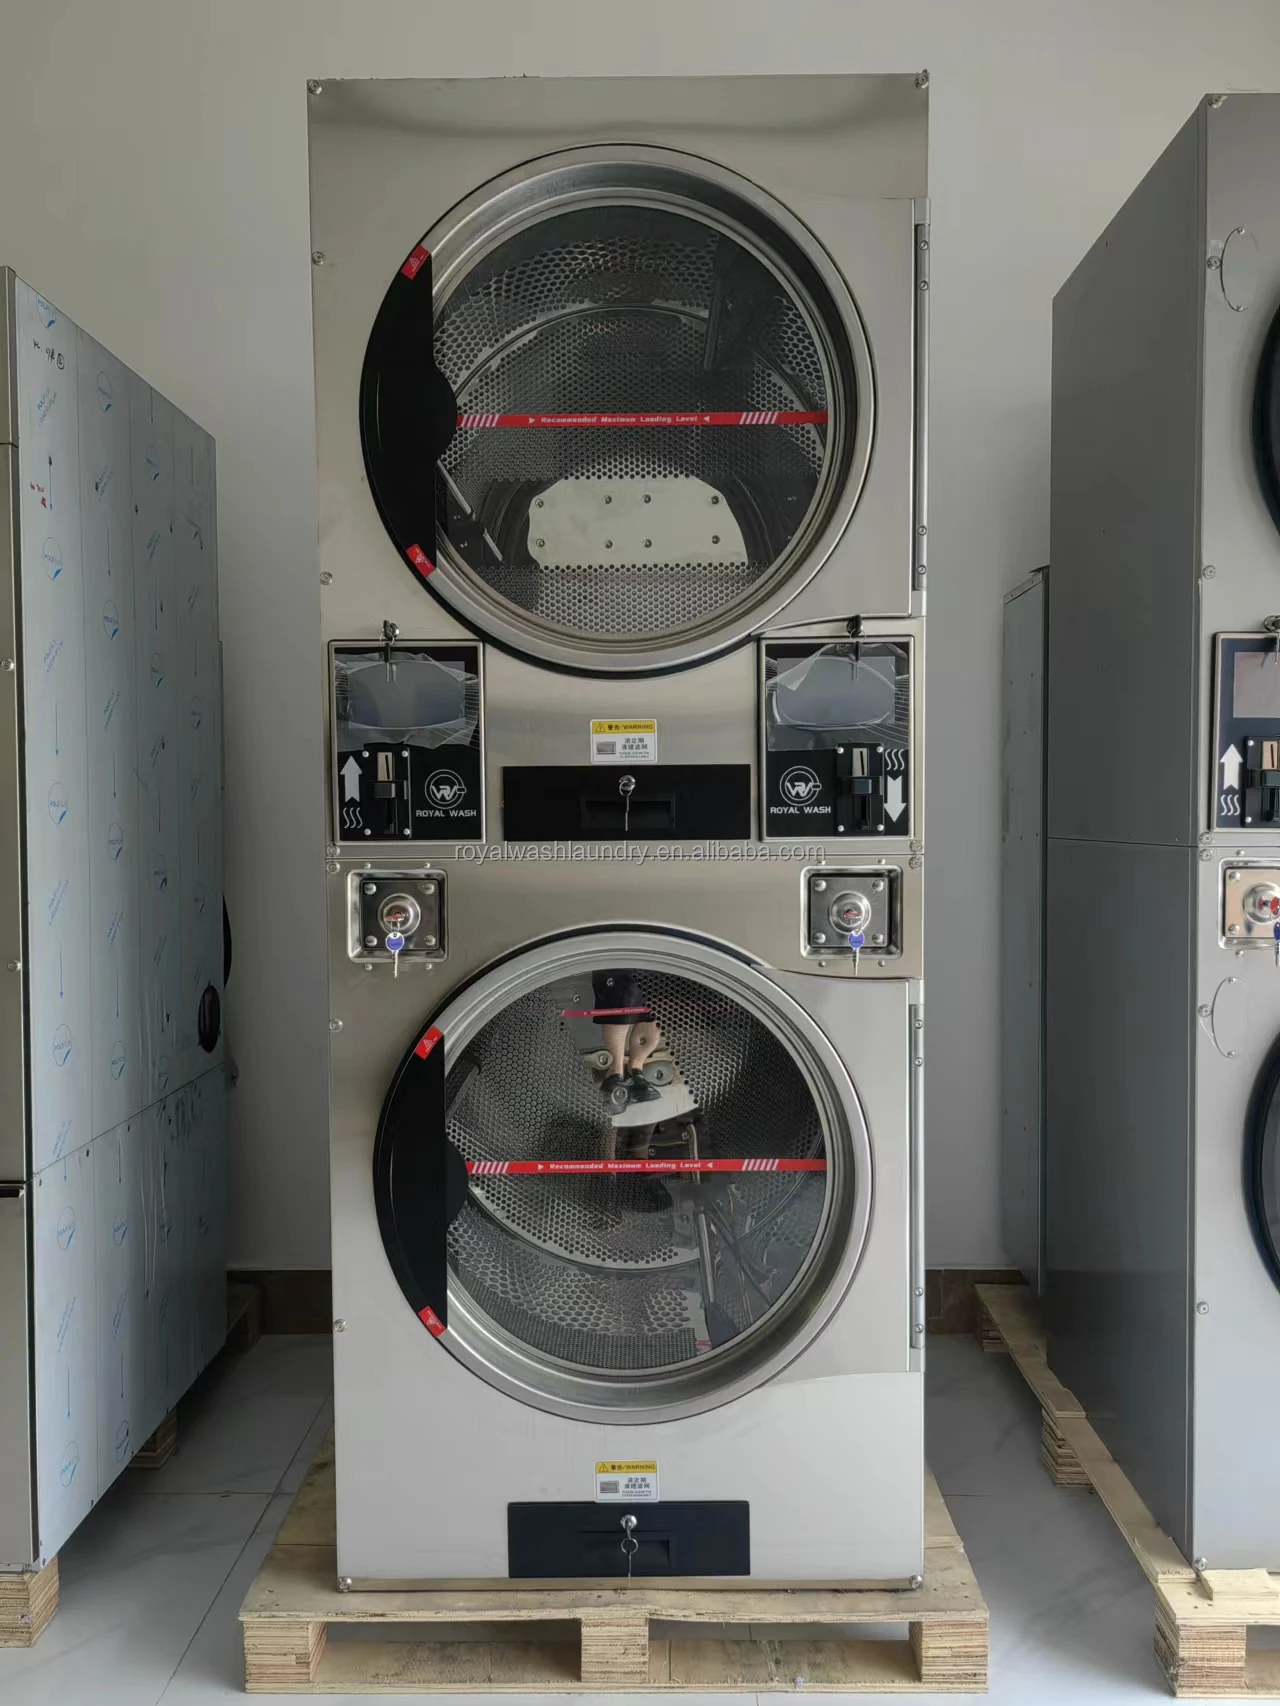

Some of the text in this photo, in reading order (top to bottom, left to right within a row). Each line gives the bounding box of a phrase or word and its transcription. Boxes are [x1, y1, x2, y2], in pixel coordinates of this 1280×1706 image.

[640, 416, 672, 424] Loading
[415, 809, 477, 818] ROYAL WASH
[770, 806, 832, 814] ROYAL WASH
[549, 1162, 604, 1170] Recommended
[645, 1162, 676, 1170] Loading
